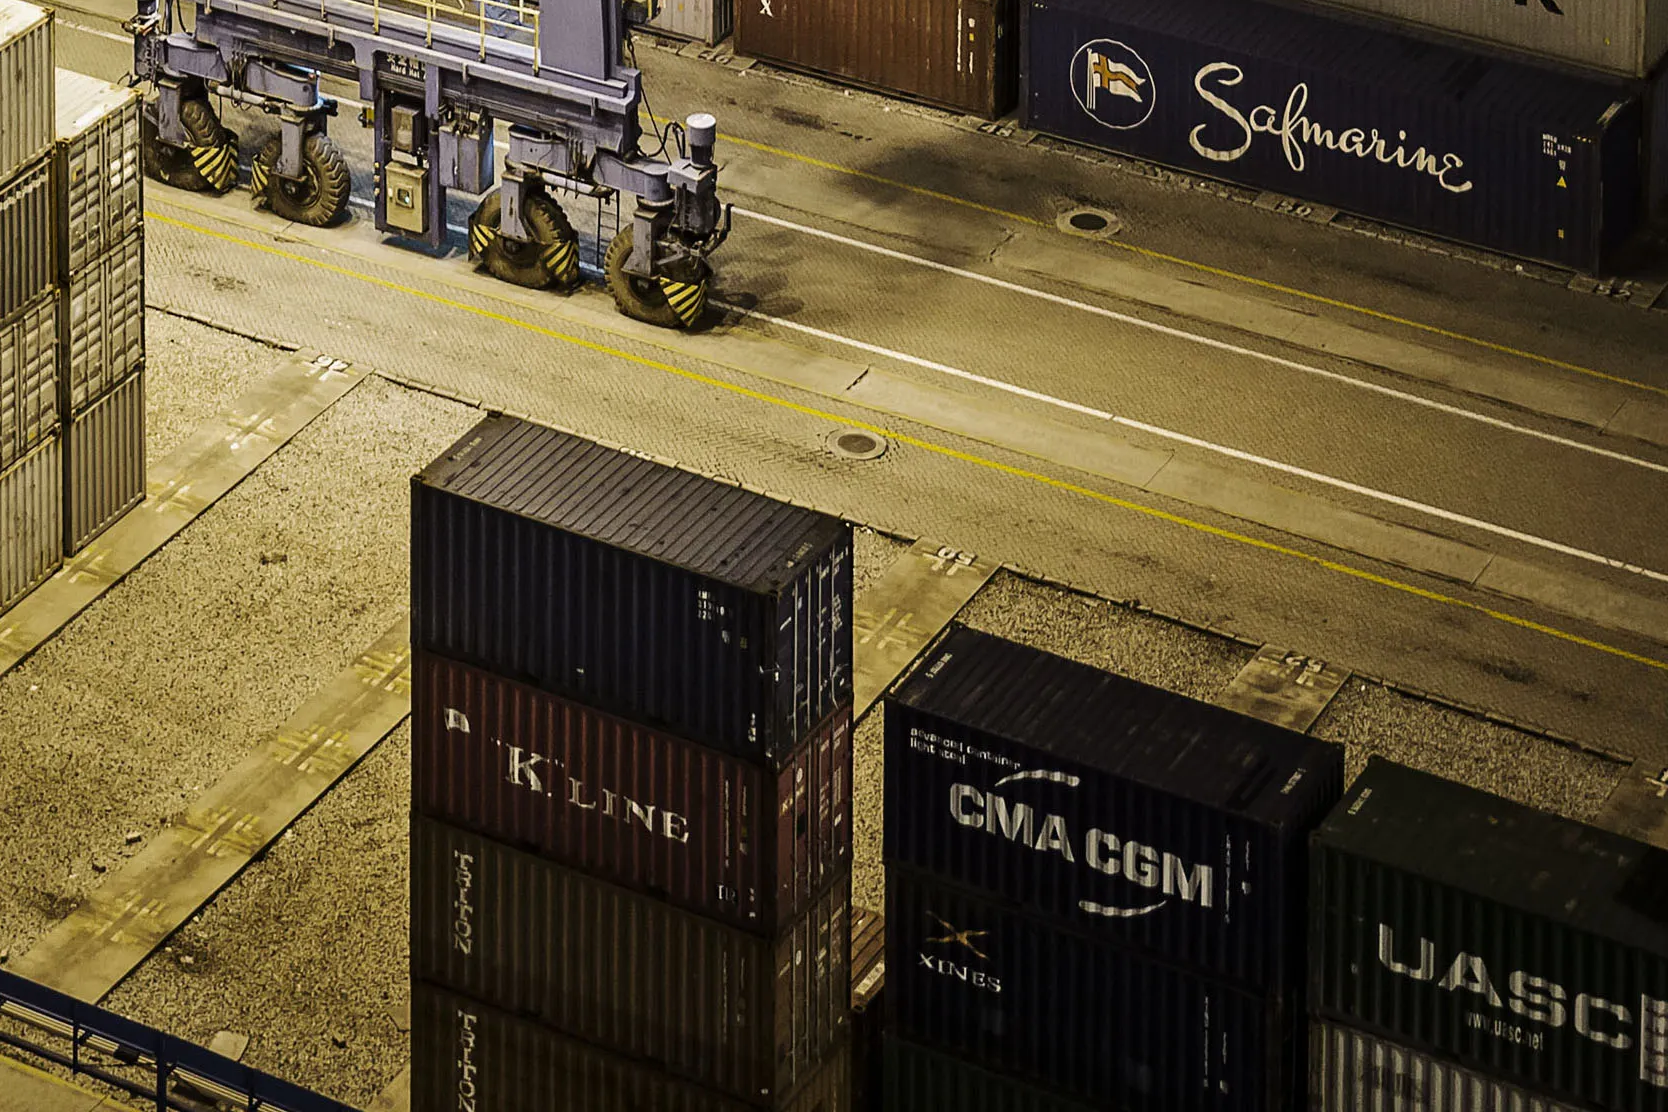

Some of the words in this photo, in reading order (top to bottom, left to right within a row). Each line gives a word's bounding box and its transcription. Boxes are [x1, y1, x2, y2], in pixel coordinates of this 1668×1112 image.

[1189, 60, 1472, 194] Safmarine
[568, 776, 690, 845] LINE
[949, 782, 1076, 864] CMA
[1085, 827, 1214, 909] CGM
[916, 951, 1003, 994] XINES
[1378, 922, 1633, 1050] UASC
